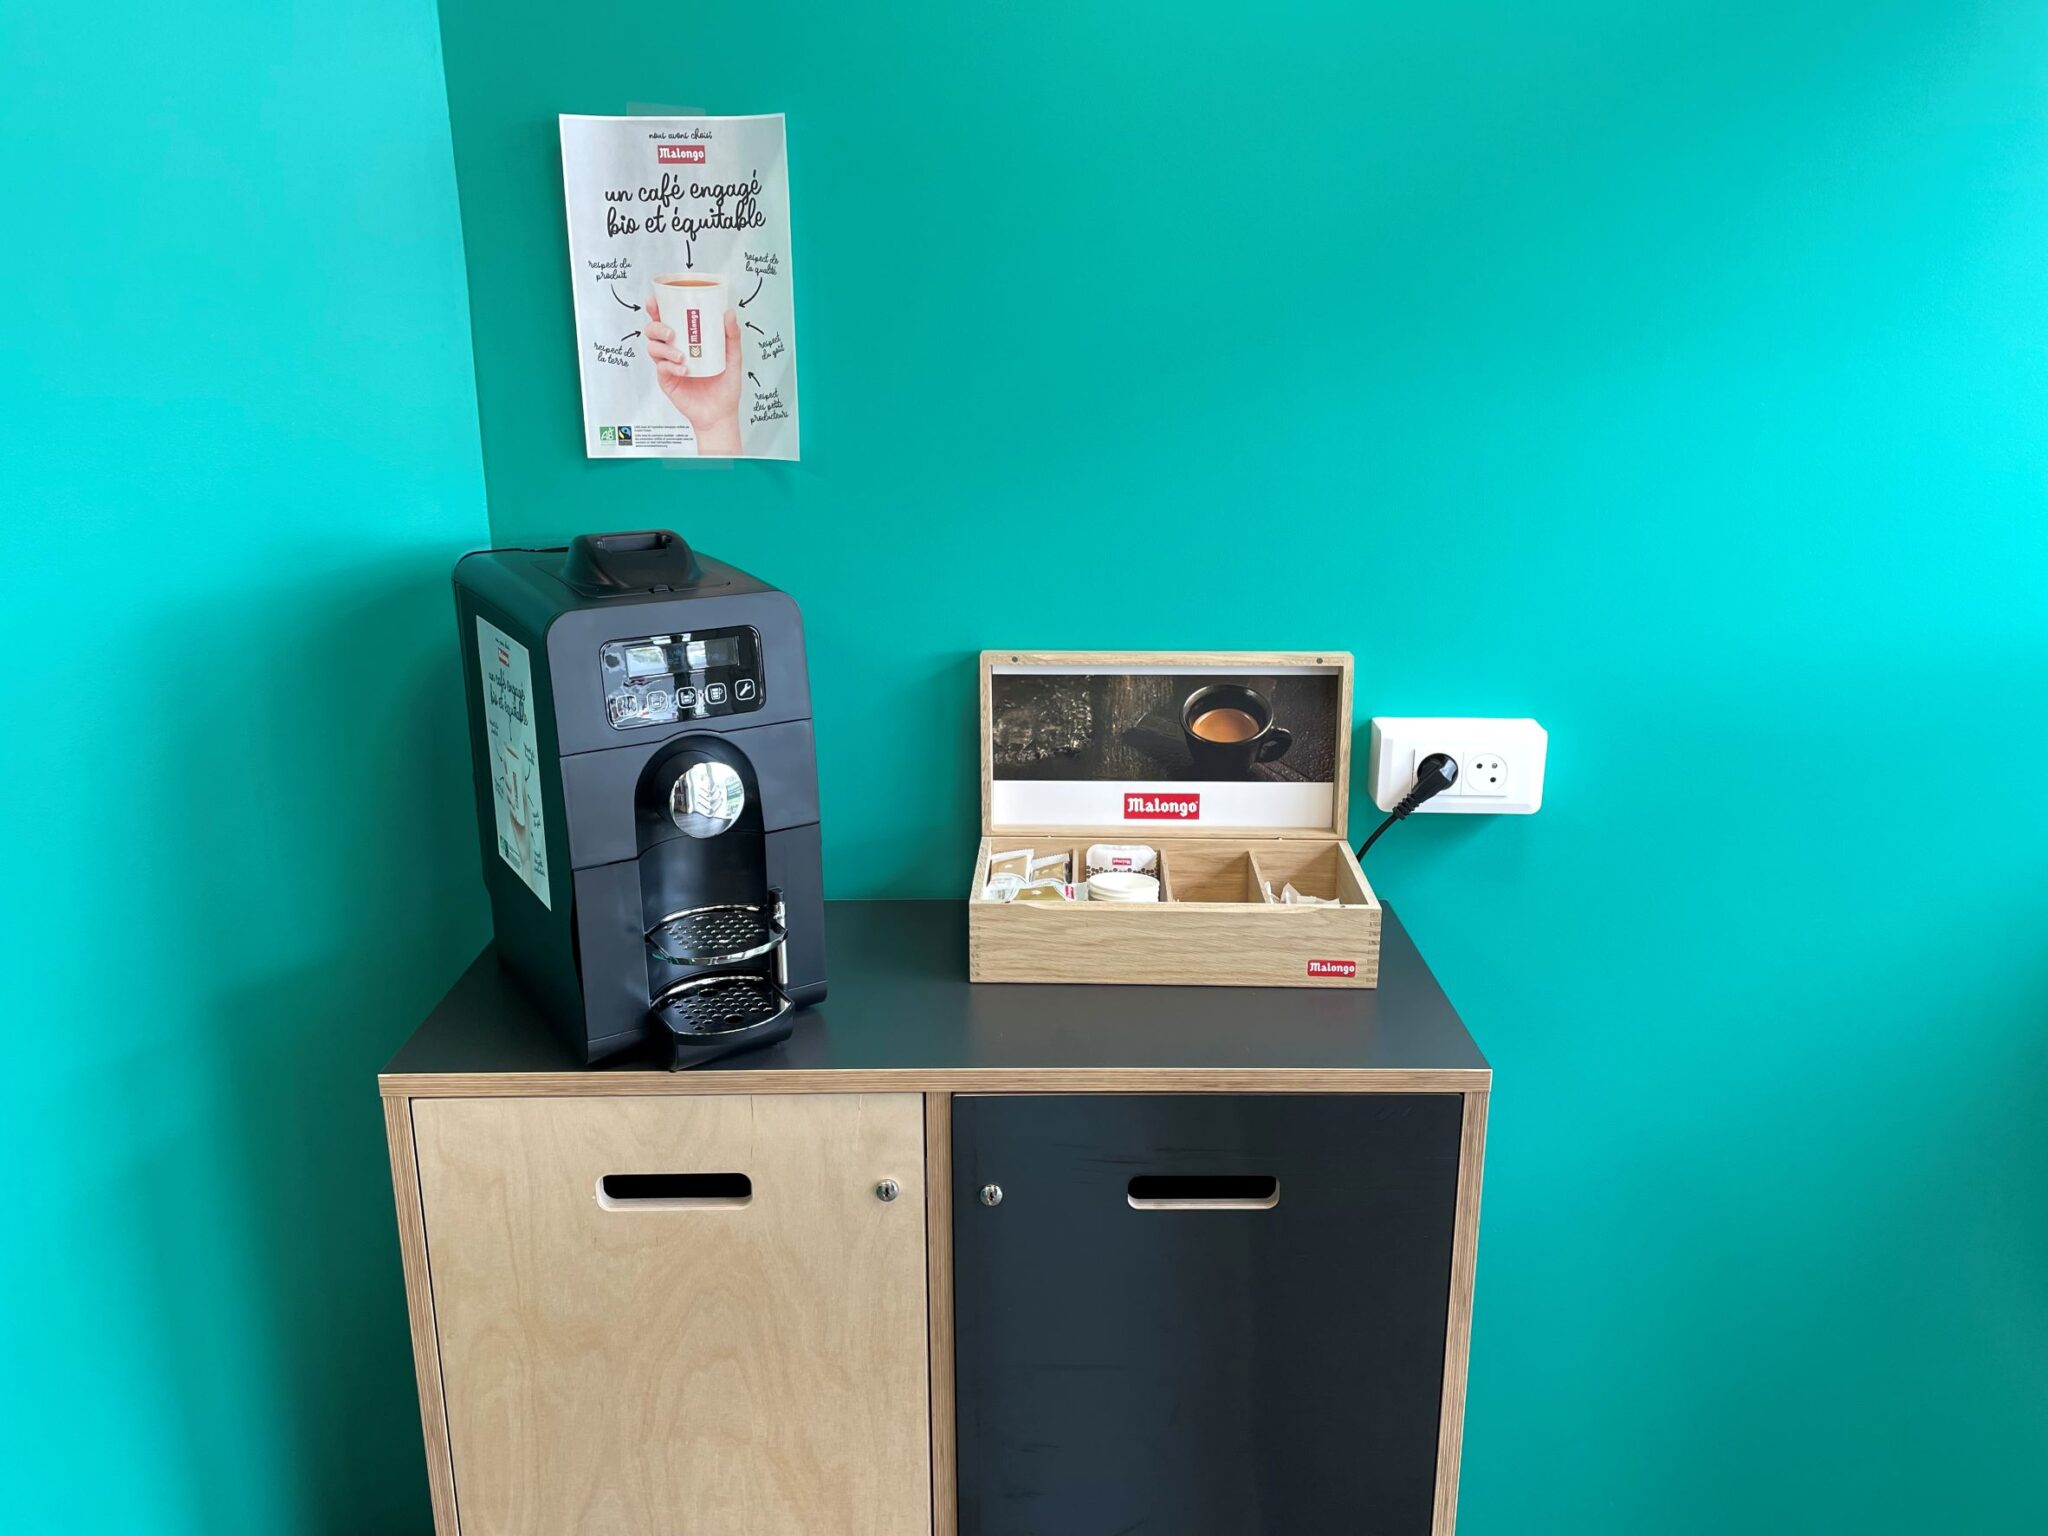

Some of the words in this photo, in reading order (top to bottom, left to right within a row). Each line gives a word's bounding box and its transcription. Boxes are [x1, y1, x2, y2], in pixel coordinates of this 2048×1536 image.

[649, 132, 666, 140] nous
[668, 132, 689, 140] avons
[691, 127, 713, 140] choisi
[659, 147, 705, 162] Malongo
[605, 189, 633, 202] un
[638, 172, 685, 208] café
[690, 169, 762, 207] engagé
[606, 206, 640, 238] bio
[645, 204, 667, 233] et
[671, 197, 767, 242] équitable
[588, 257, 618, 271] respect
[619, 257, 632, 269] du
[745, 260, 754, 272] la
[596, 268, 628, 283] produit
[690, 310, 699, 343] Malongo
[593, 341, 623, 355] respect
[623, 346, 636, 358] de
[597, 351, 607, 362] la
[607, 353, 629, 368] terre
[1127, 797, 1198, 818] Malongo
[1309, 962, 1356, 975] Malongo
